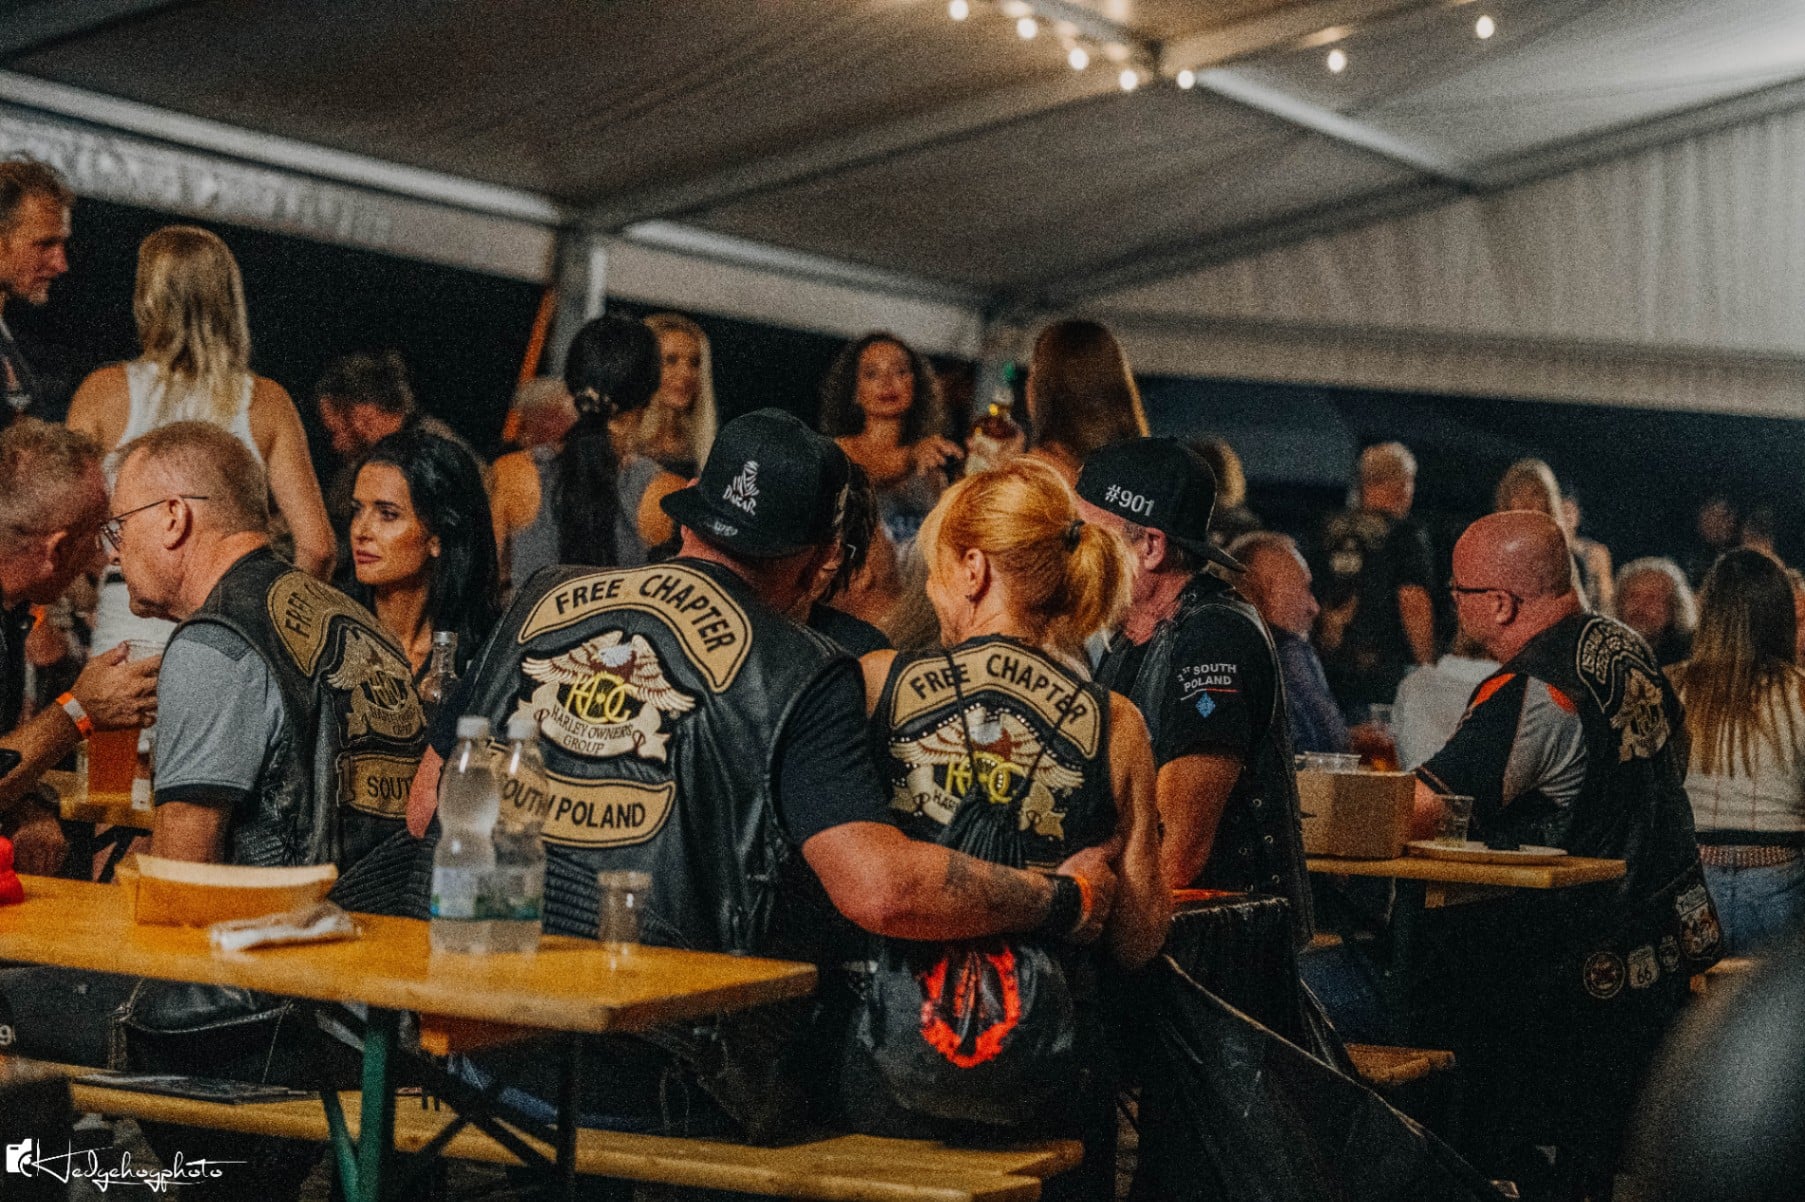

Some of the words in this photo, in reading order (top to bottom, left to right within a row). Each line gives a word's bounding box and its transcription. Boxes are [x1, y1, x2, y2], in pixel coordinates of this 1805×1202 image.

[1105, 484, 1155, 517] #901
[555, 578, 625, 615] FREE
[638, 574, 736, 652] CHAPTER
[1183, 675, 1232, 692] POLAND
[1193, 663, 1237, 676] SOUTH
[909, 663, 971, 700] FREE
[986, 654, 1088, 724] CHAPTER
[551, 704, 588, 736] HARLEY
[588, 723, 634, 740] OWNERS
[563, 735, 605, 755] GROUP
[367, 775, 413, 800] SOUT
[500, 772, 556, 816] OUTH
[555, 797, 646, 829] POLAND
